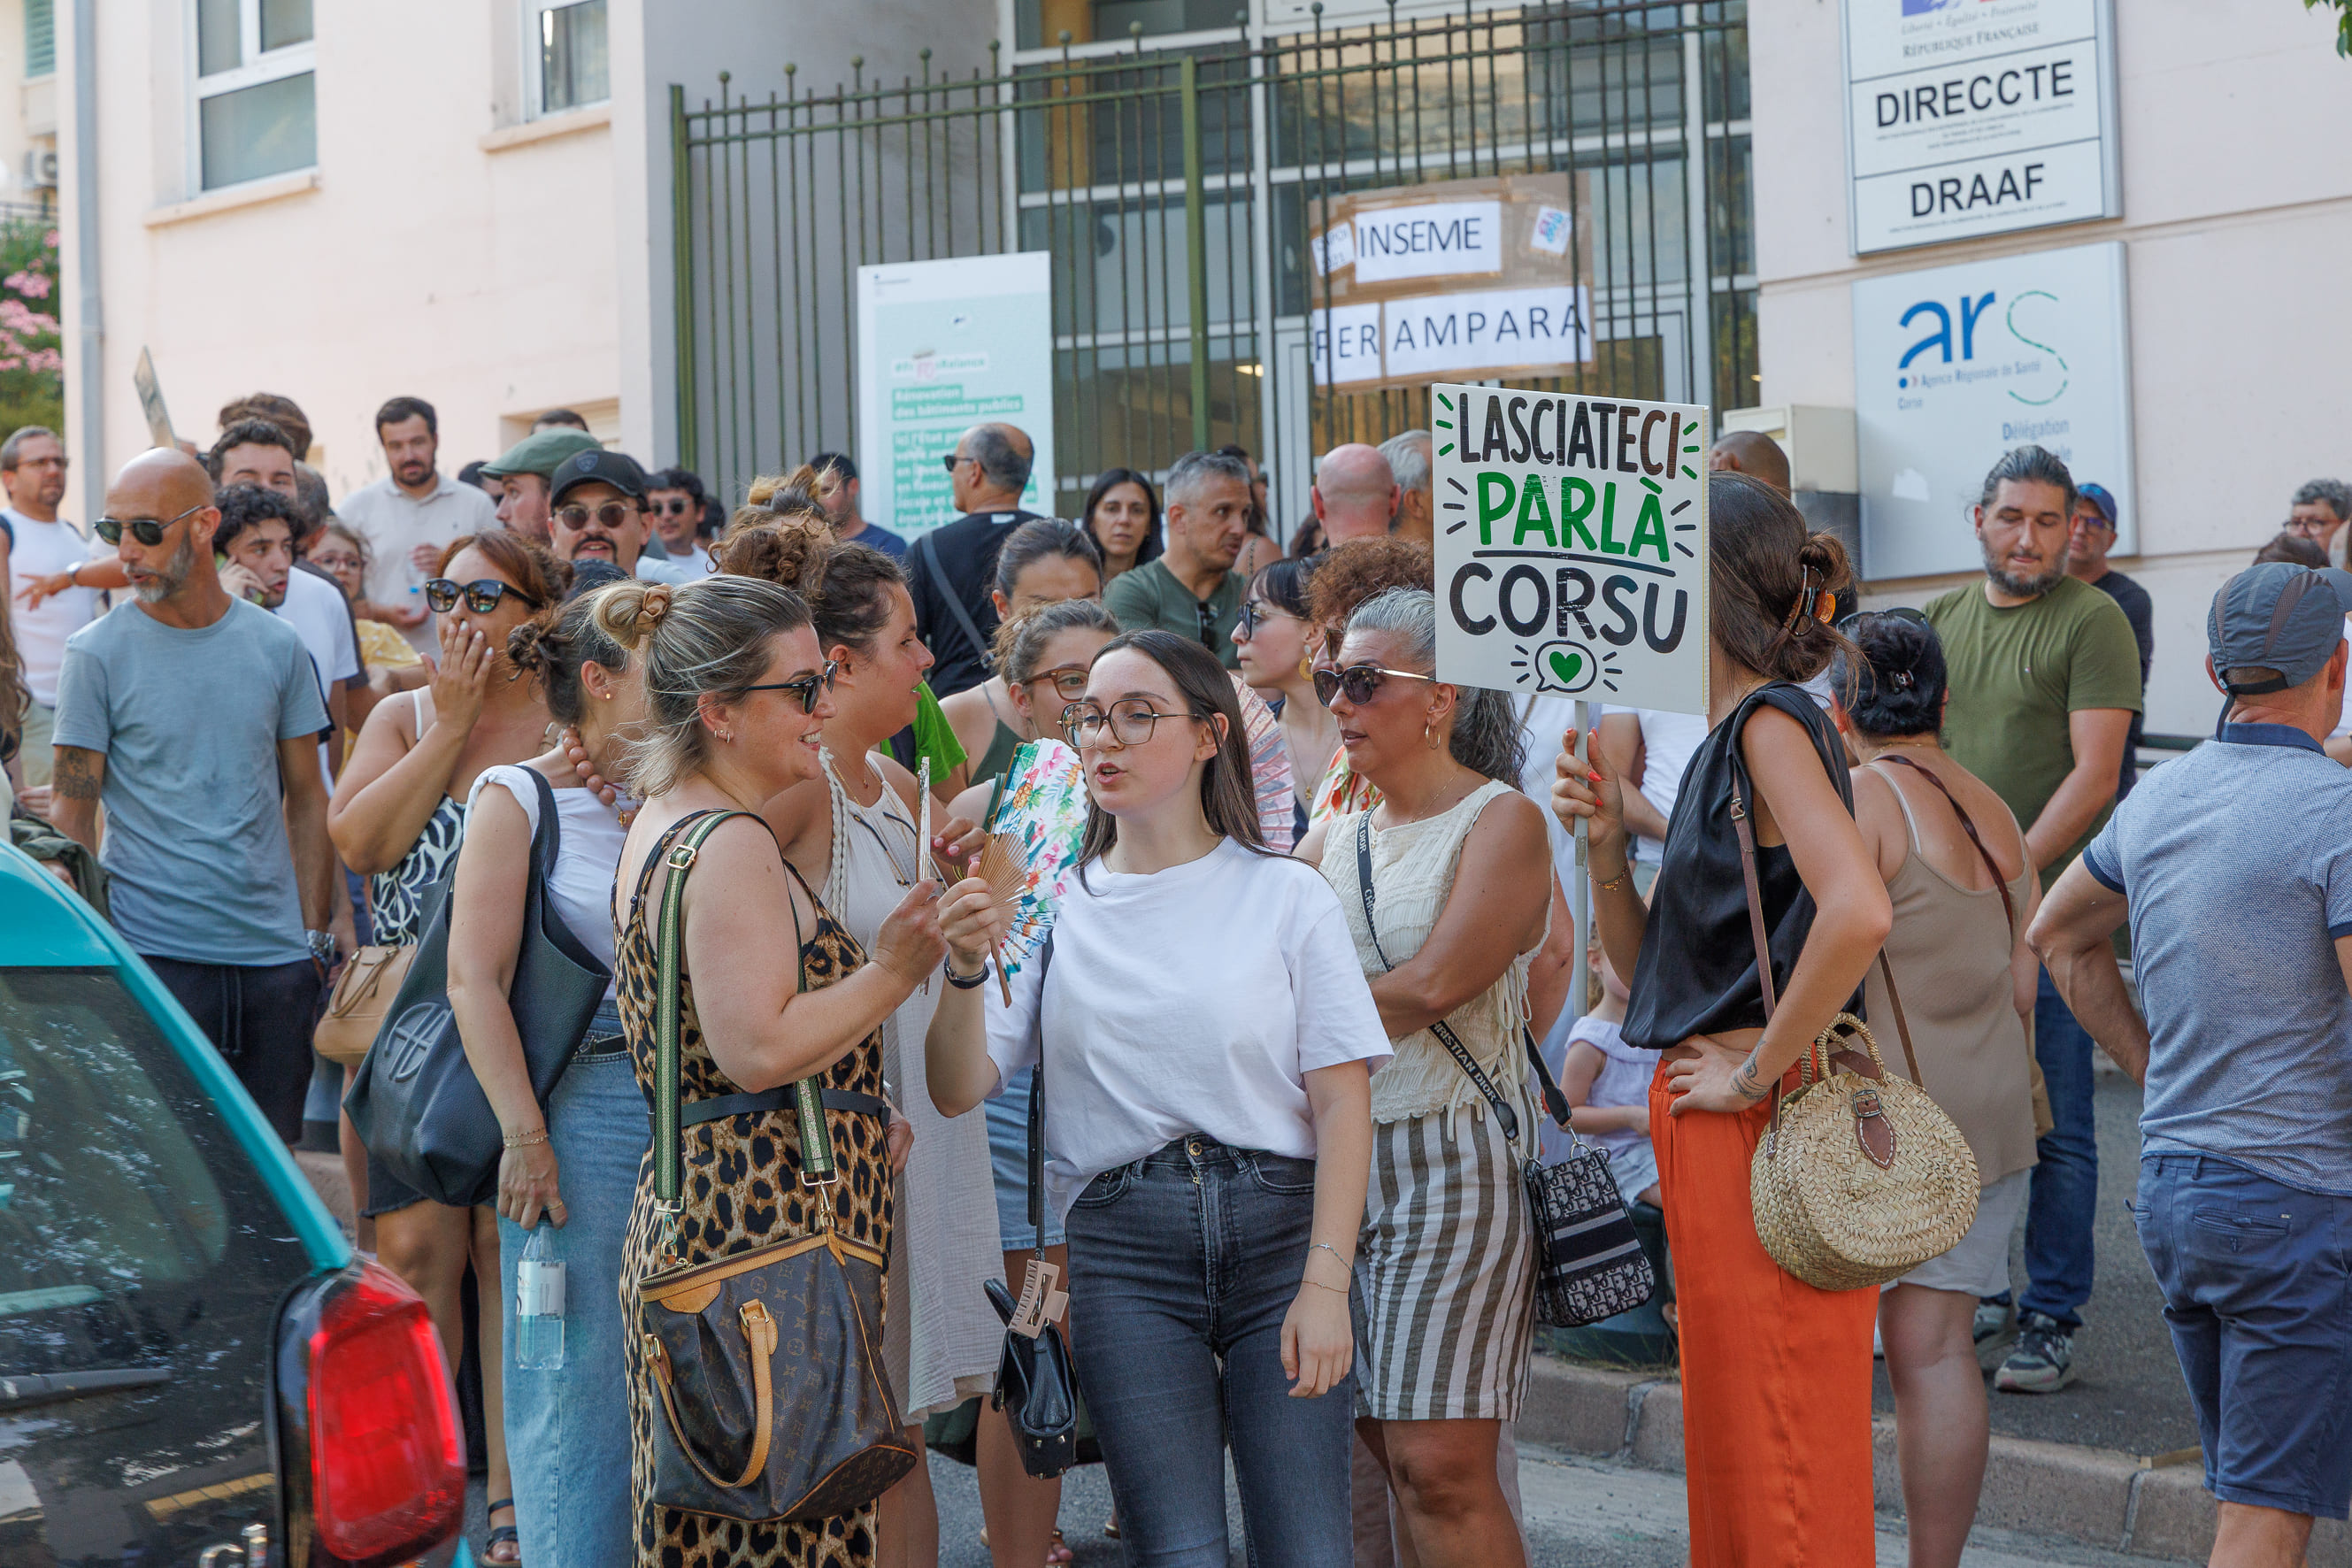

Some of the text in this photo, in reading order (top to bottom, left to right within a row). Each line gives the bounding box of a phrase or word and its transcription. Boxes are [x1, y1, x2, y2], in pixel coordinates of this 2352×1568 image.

[1877, 59, 2073, 127] DIRECCTE
[1911, 163, 2044, 217] DRAAF
[1359, 218, 1482, 257] INSEME
[1394, 304, 1587, 351] AMPARA
[1921, 371, 1952, 388] Agence
[2002, 364, 2012, 376] de
[2015, 359, 2041, 376] Santé
[979, 397, 1020, 413] publics
[1459, 392, 1680, 480] LASCIATECI
[2002, 419, 2070, 442] Délégation
[1477, 471, 1670, 563] PARLÀ
[1449, 561, 1688, 654] CORSU
[1474, 1072, 1496, 1102] DIOR
